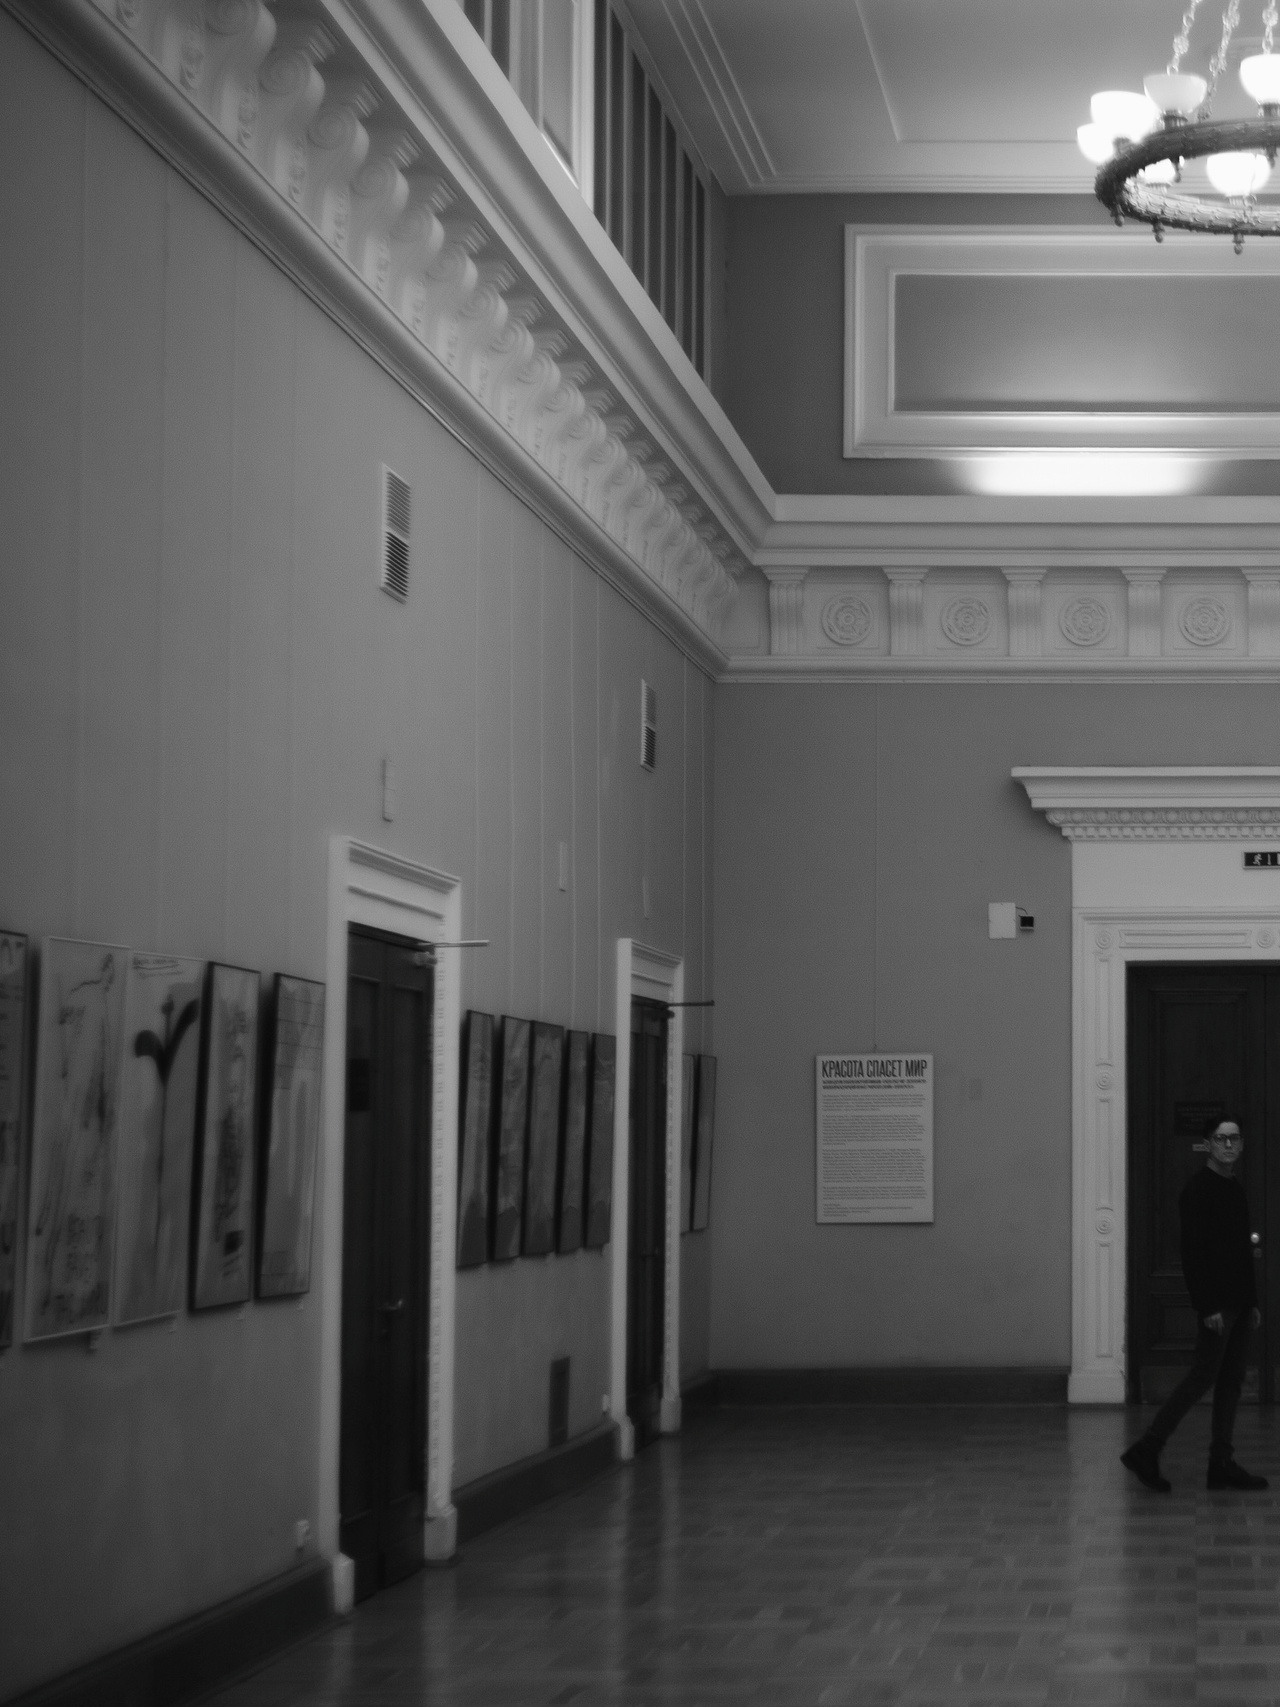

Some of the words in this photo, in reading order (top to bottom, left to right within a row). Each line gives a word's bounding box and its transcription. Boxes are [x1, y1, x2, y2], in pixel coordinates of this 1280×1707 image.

[822, 1060, 864, 1078] КРАСОТА
[866, 1060, 903, 1077] СПАСЕТ
[905, 1059, 927, 1077] МИР
